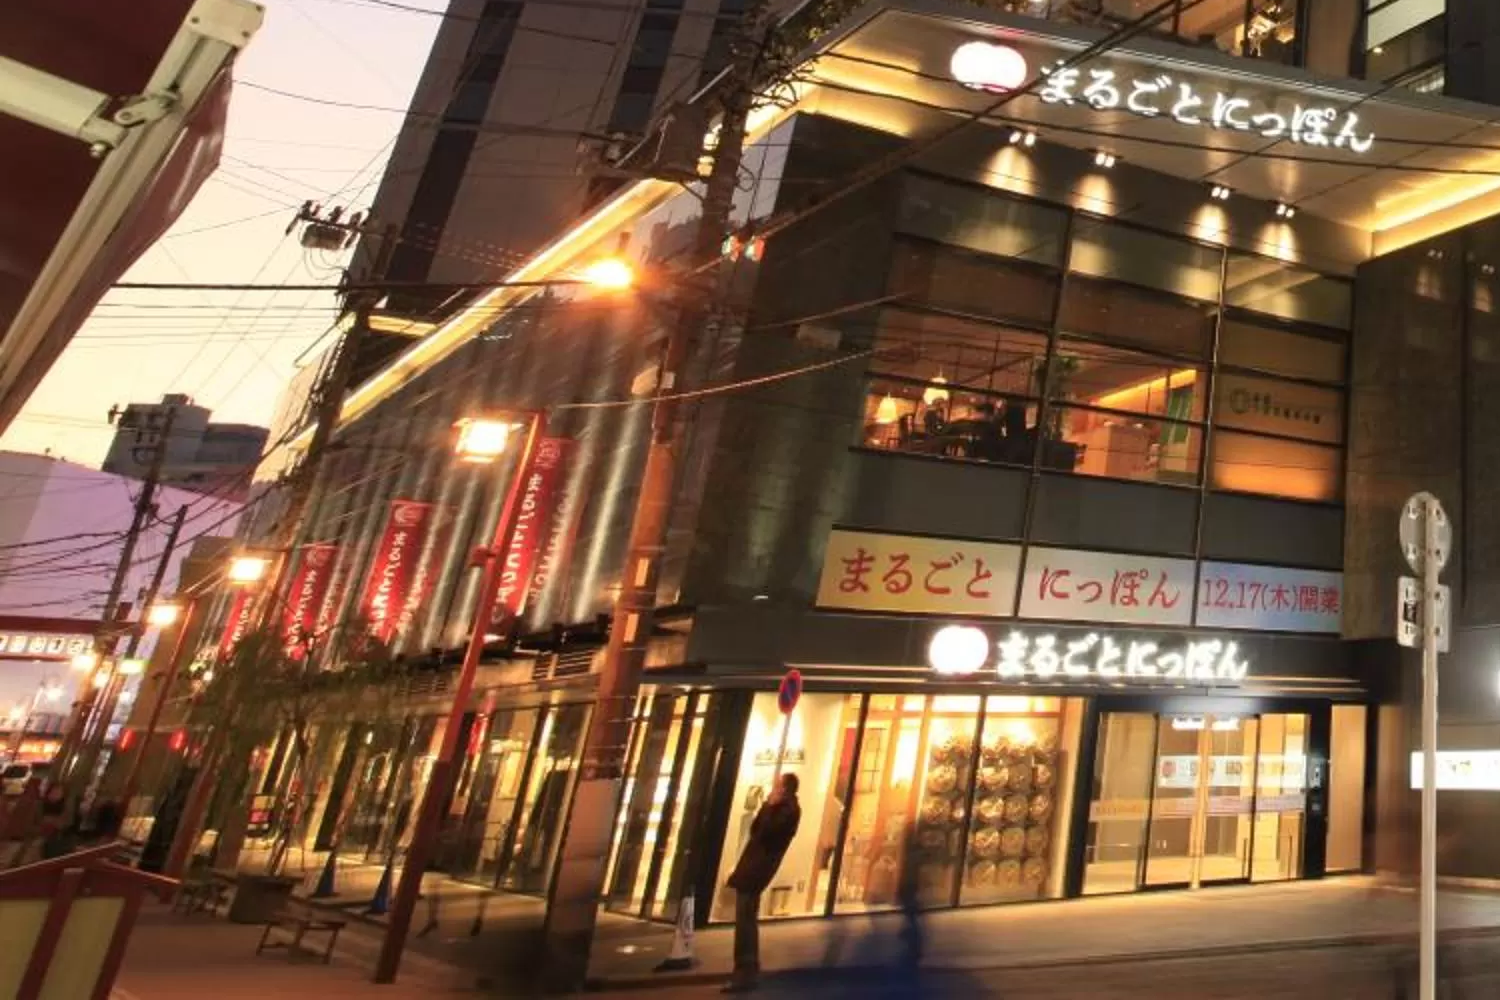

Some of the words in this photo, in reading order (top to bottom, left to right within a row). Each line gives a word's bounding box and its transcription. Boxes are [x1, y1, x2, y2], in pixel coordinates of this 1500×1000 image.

[1039, 59, 1375, 152] まるごとにっぽん
[838, 547, 994, 598] まるごと
[1038, 566, 1180, 610] にっぽん
[996, 632, 1249, 681] まるごとにっぽん
